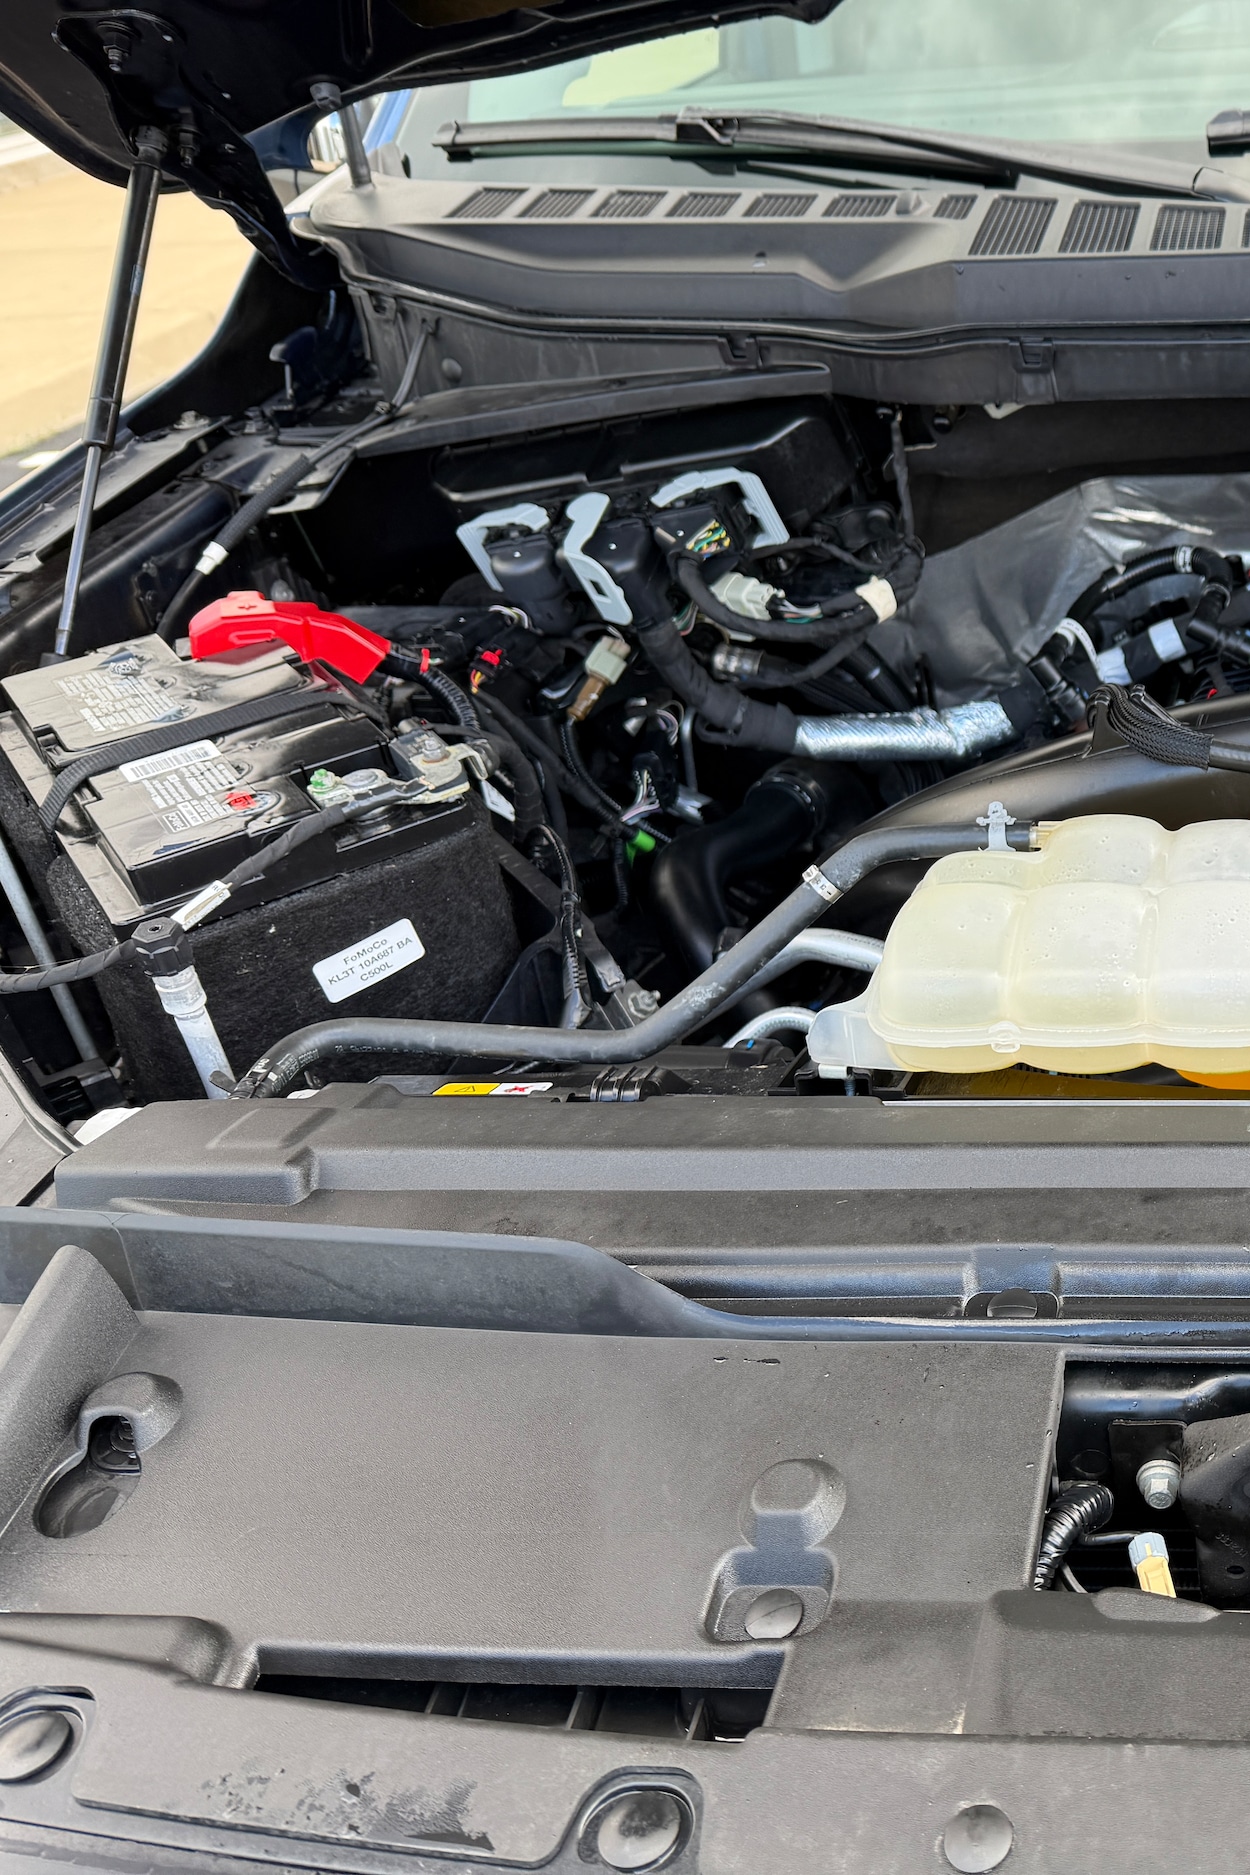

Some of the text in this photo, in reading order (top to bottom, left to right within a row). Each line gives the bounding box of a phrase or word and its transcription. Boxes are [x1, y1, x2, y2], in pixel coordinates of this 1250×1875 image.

[327, 937, 413, 985] KL3T 10A687 BA
[343, 938, 388, 965] FoMoCo
[360, 961, 394, 982] C500L
